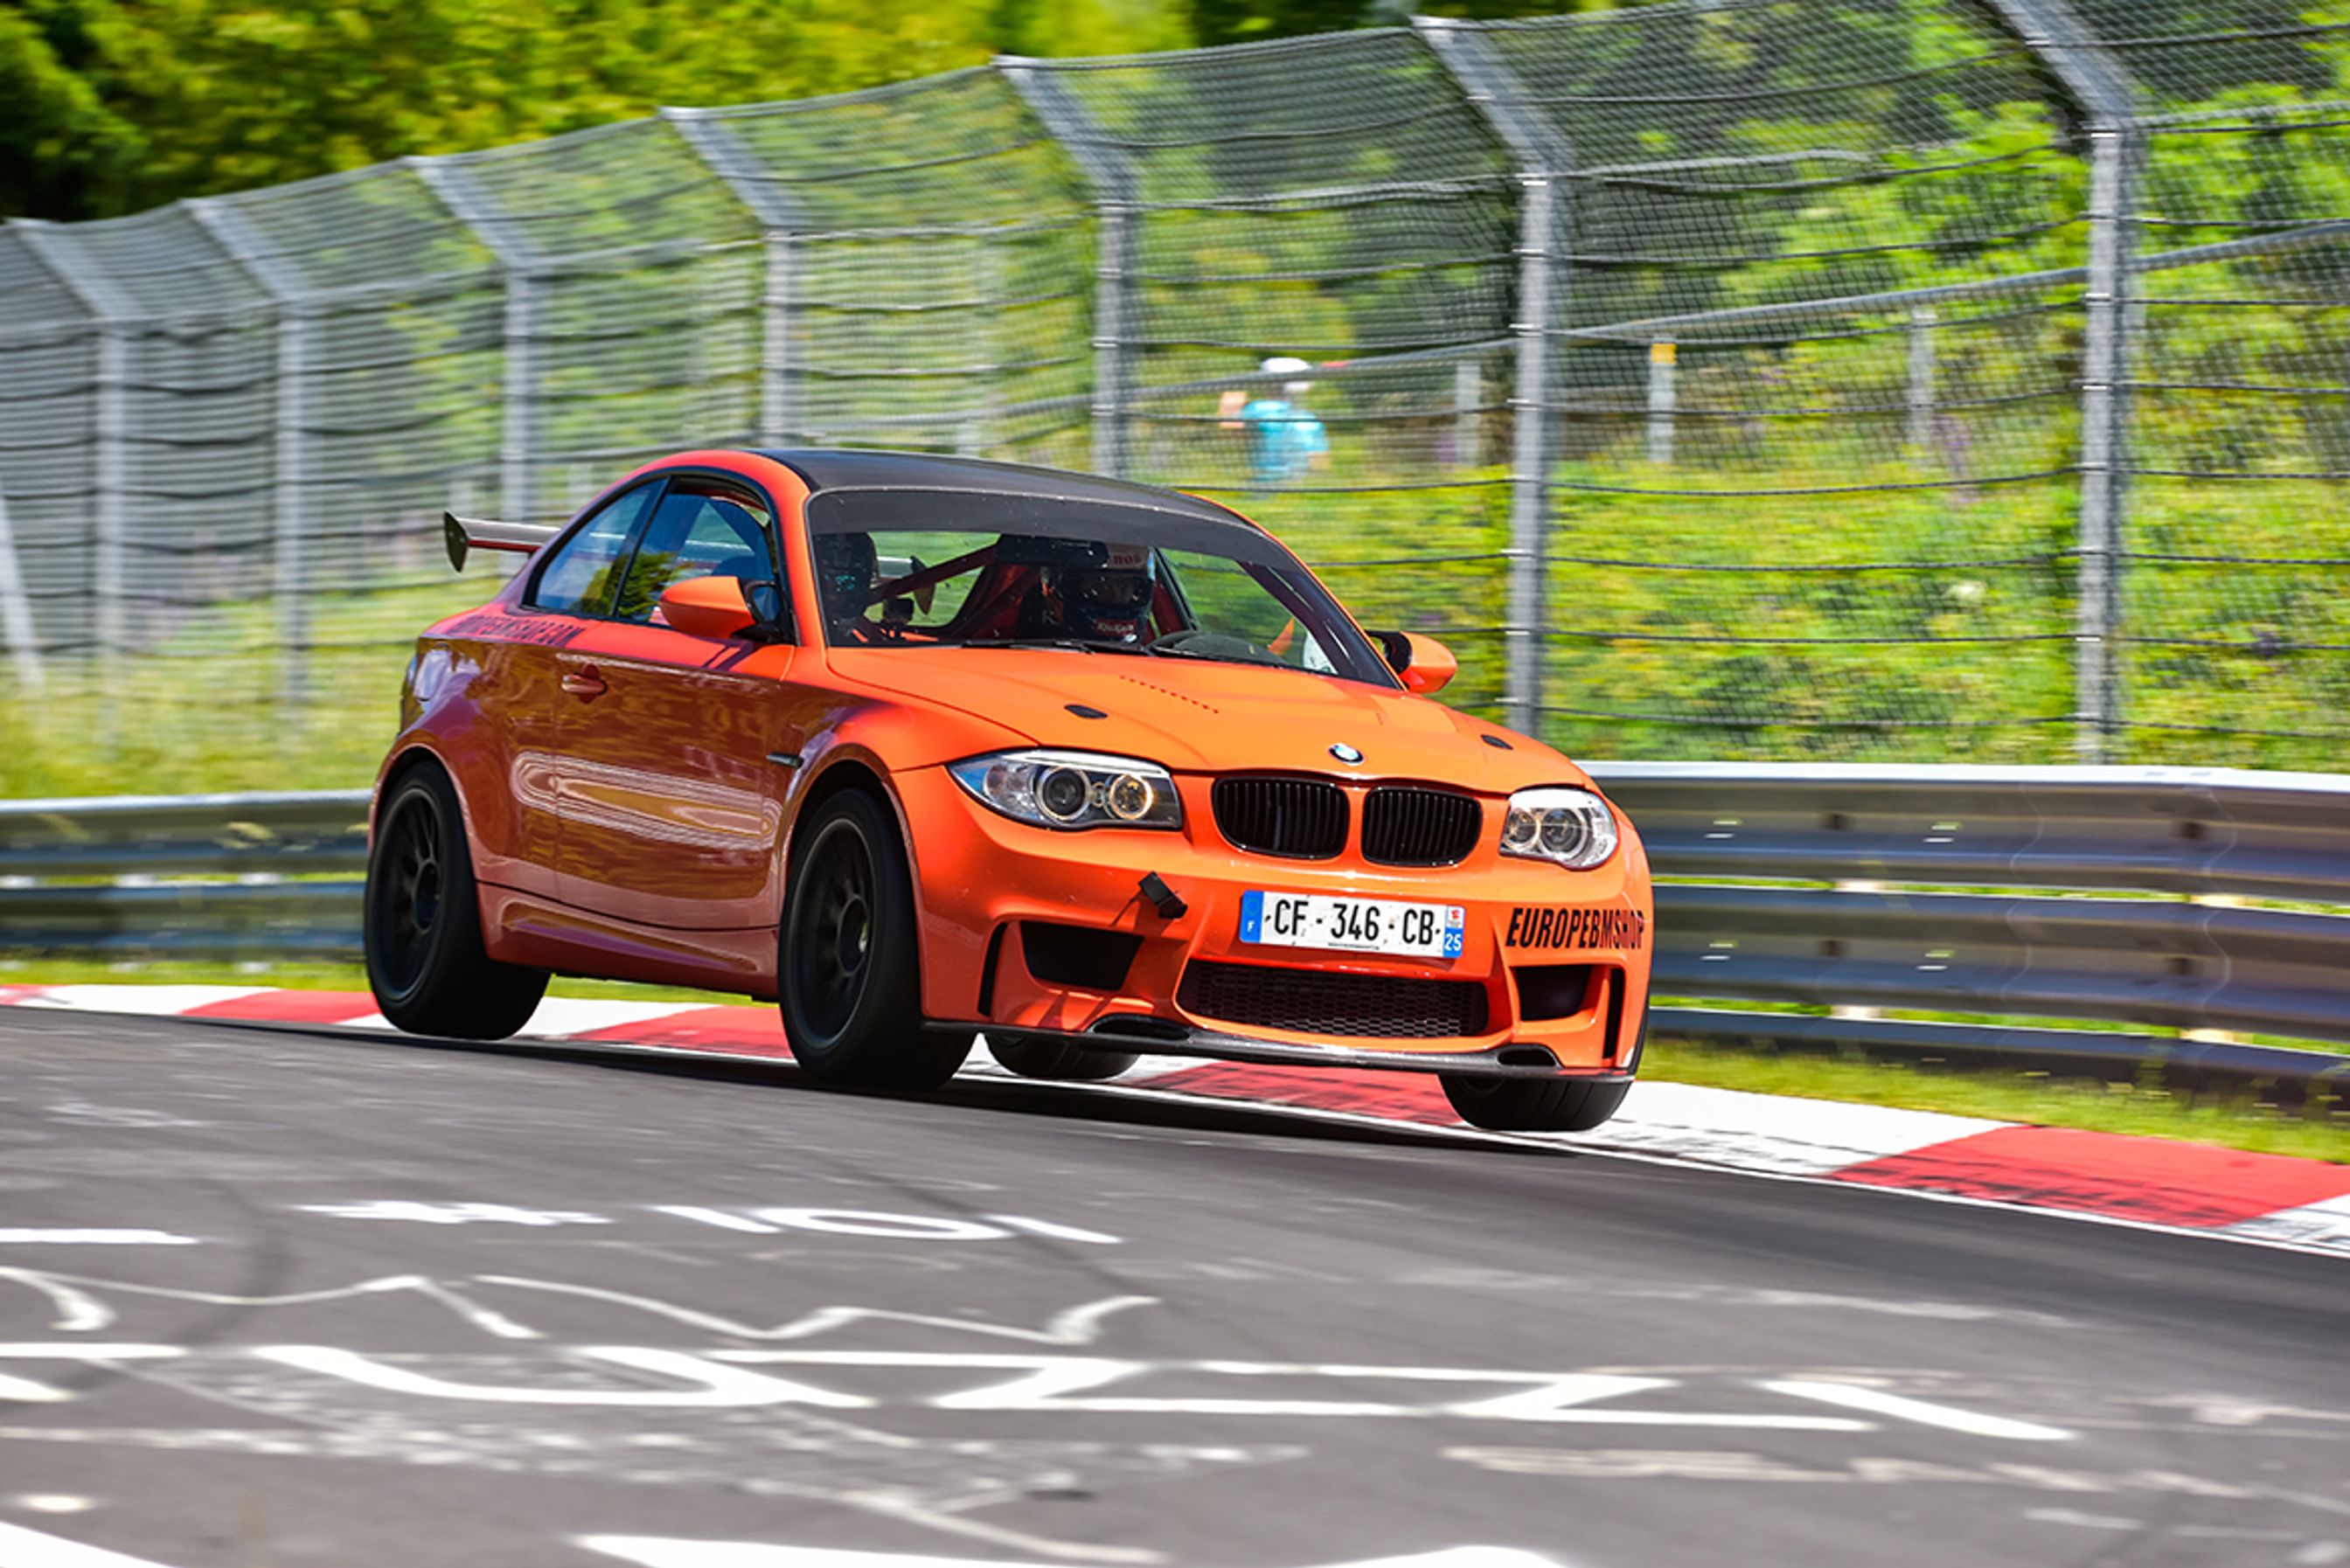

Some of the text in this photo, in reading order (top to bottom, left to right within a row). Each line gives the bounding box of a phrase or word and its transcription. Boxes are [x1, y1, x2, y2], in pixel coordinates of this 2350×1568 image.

[1247, 920, 1255, 933] F
[1505, 907, 1644, 949] EUROPEBMSHOP
[1444, 933, 1462, 951] 25
